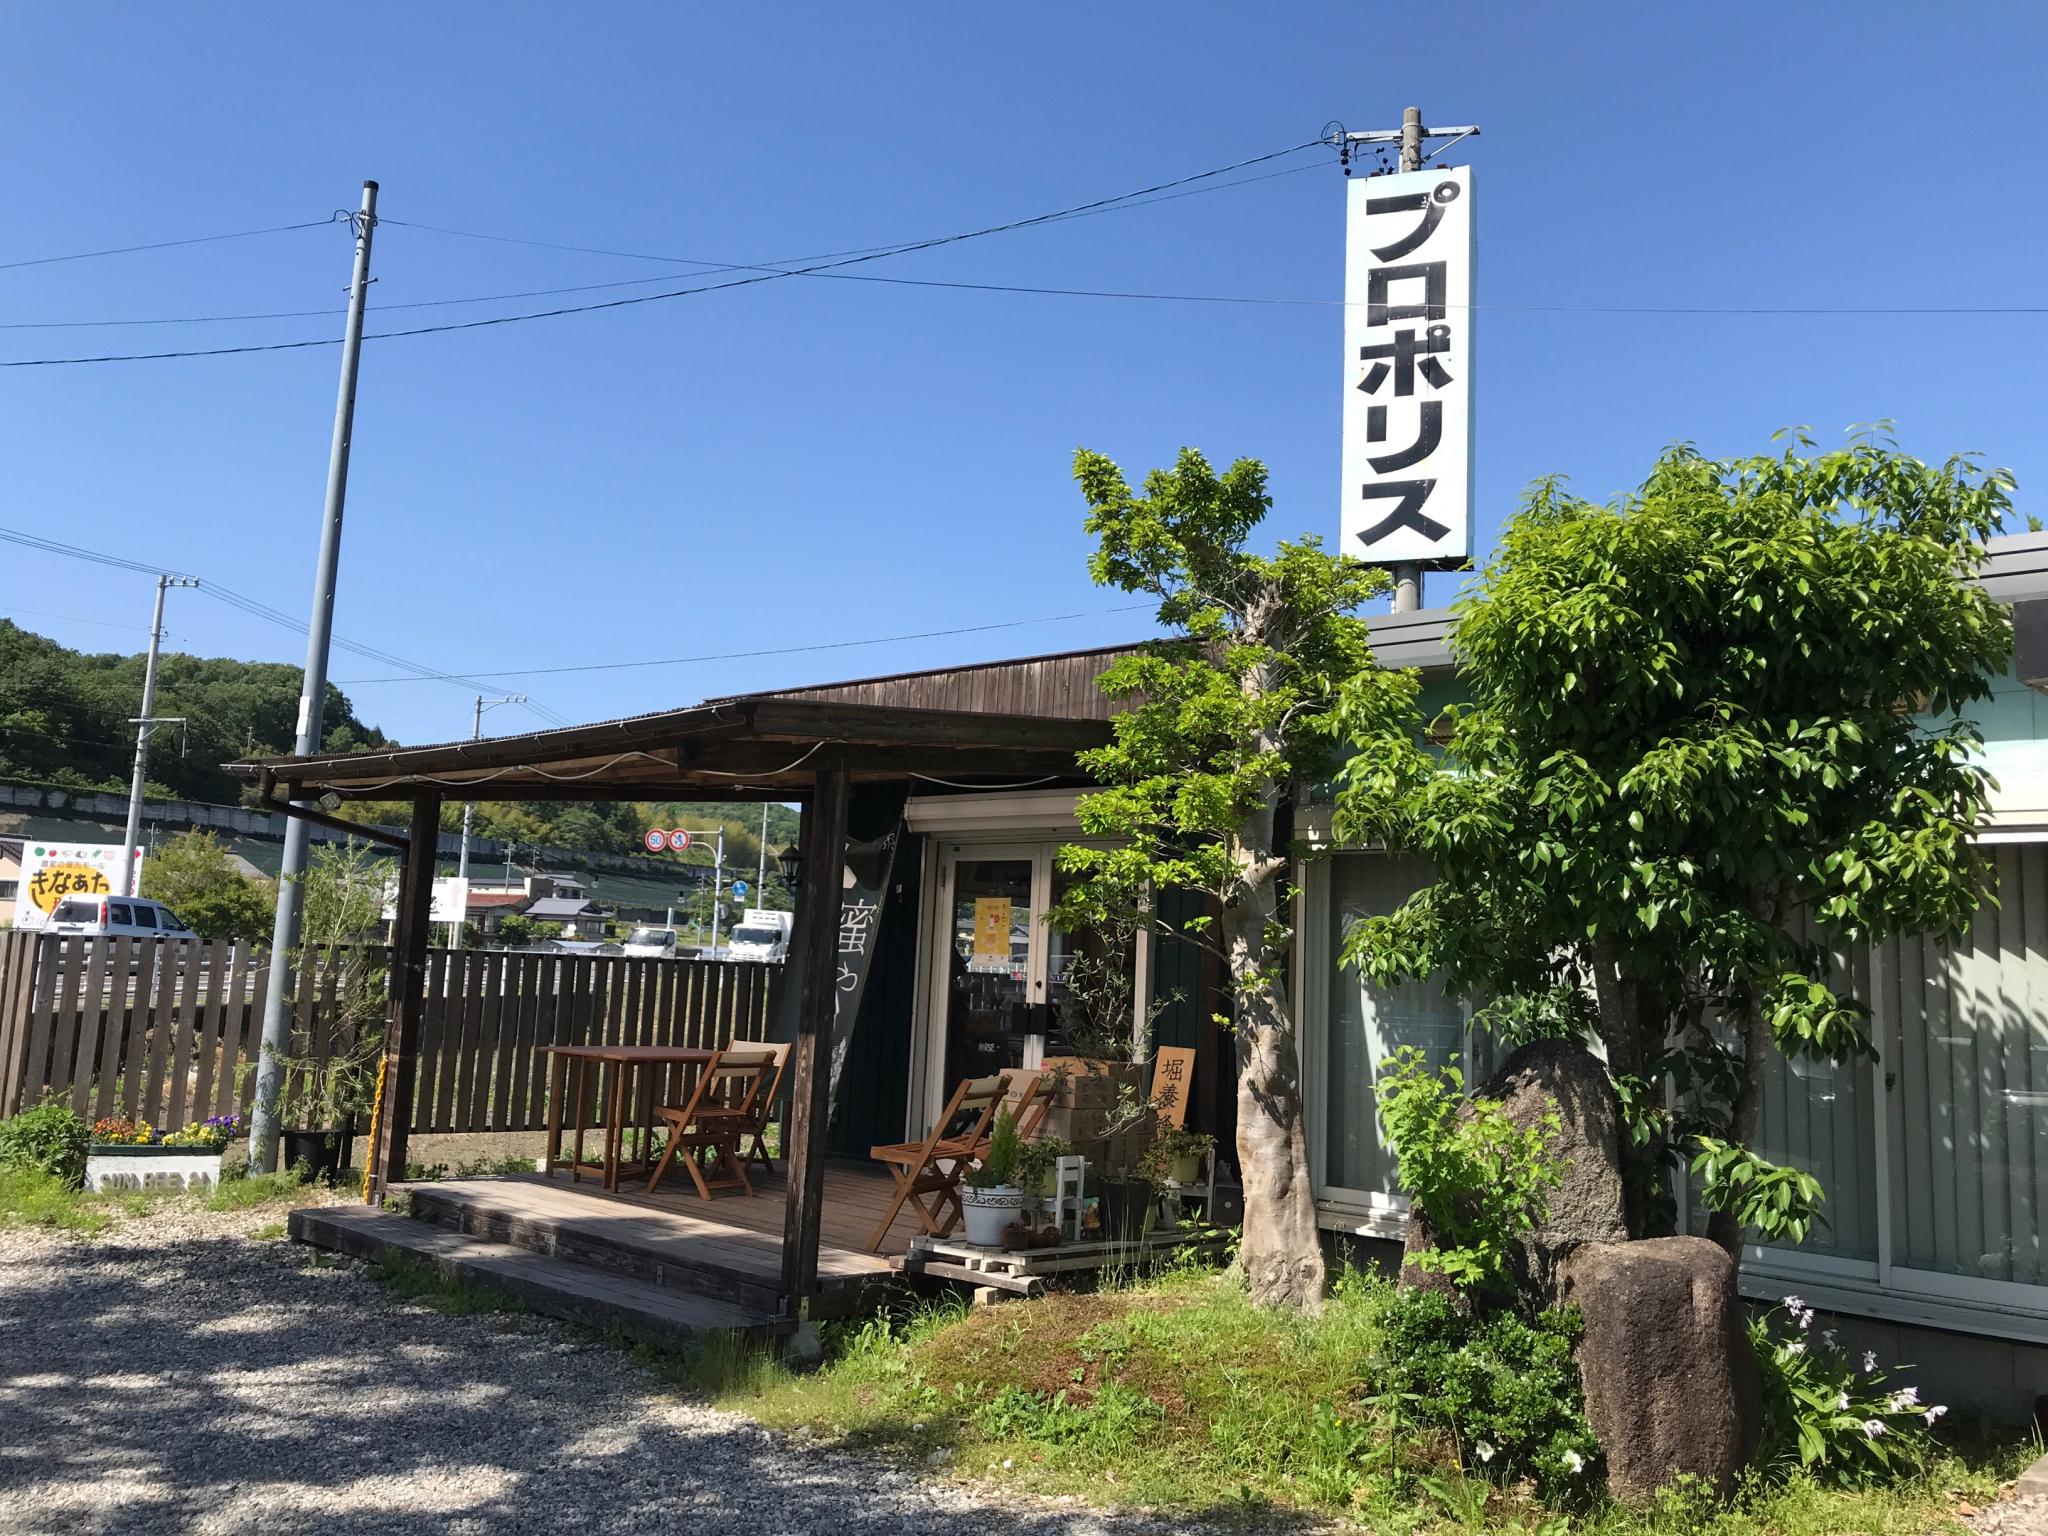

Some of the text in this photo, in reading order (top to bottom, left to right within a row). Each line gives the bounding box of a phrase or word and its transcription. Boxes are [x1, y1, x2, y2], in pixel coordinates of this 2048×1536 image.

[1356, 181, 1461, 547] プロポリス
[650, 834, 662, 845] 50
[835, 898, 878, 1012] 蜜や
[100, 1172, 138, 1191] SUN
[143, 1171, 183, 1190] BEE
